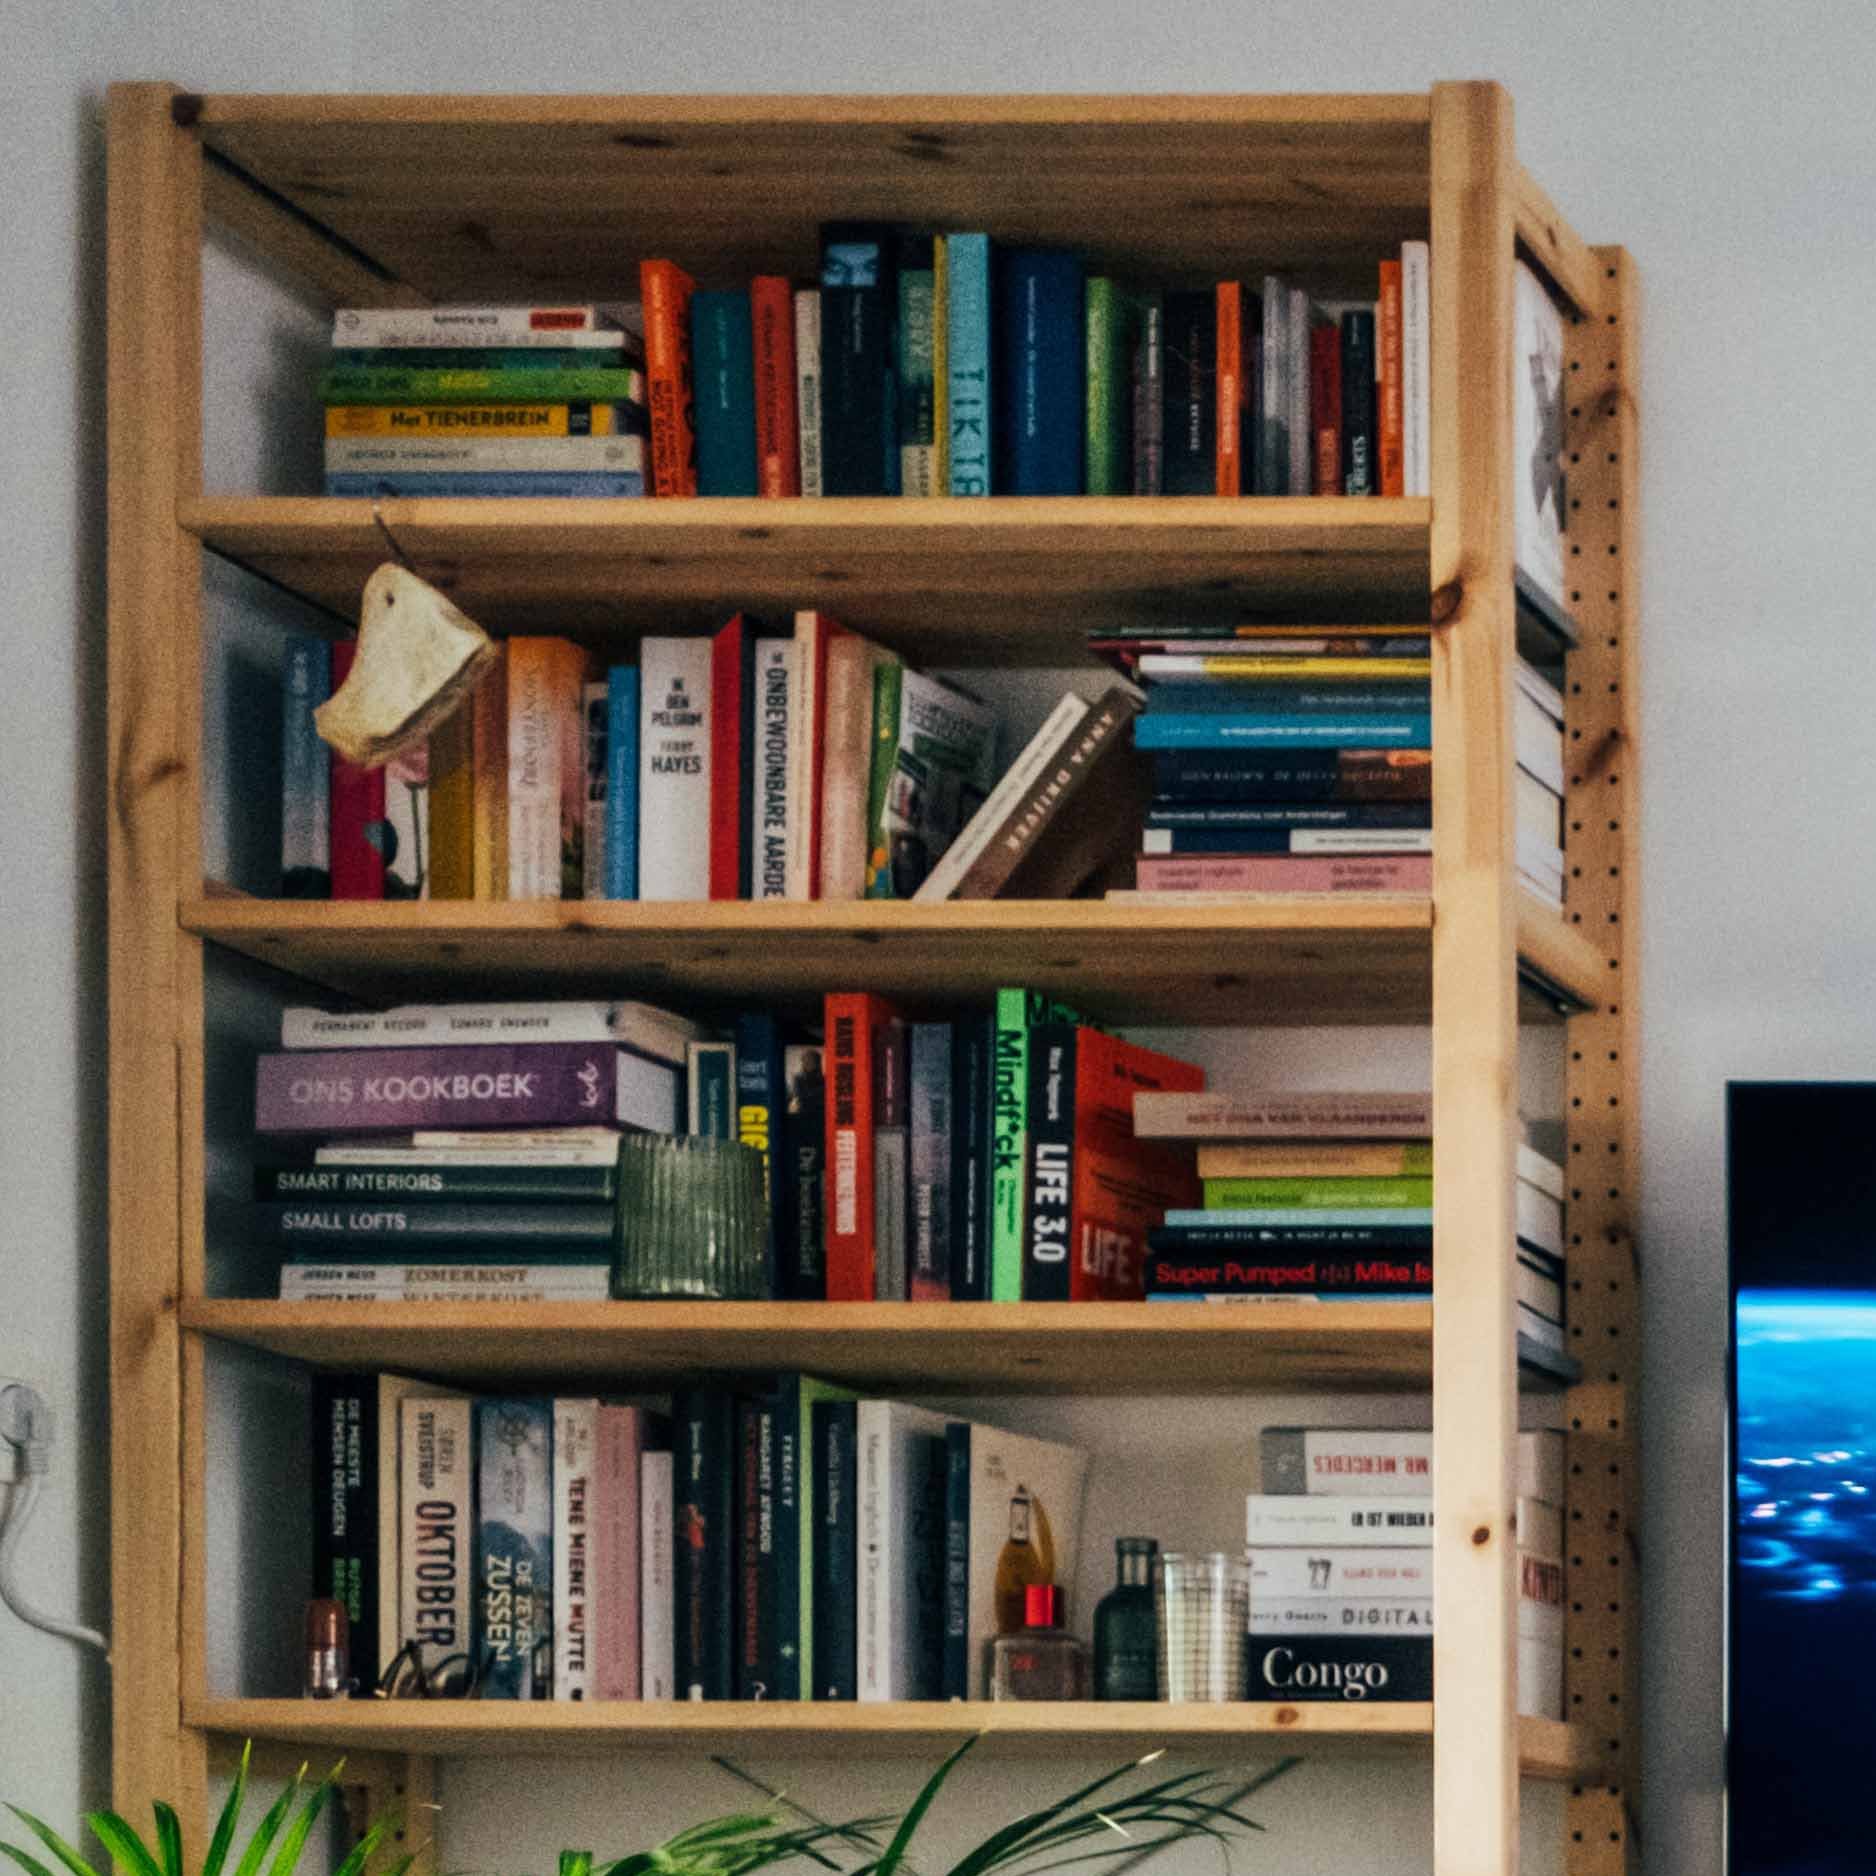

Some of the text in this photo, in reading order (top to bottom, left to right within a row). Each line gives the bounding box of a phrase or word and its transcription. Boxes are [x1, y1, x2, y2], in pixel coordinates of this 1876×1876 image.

[426, 410, 550, 427] TIENERBREIN
[651, 755, 702, 775] HAYES
[765, 667, 789, 828] ONBEWOONBARE
[1068, 711, 1118, 768] ANNA
[763, 834, 788, 898] AARDE
[288, 1072, 534, 1105] ONS KOOKBOEK
[276, 1172, 444, 1193] SMART INTERIORS
[1033, 1142, 1069, 1263] LIFE 3.0
[281, 1212, 407, 1231] SMALL LOFTS
[403, 1266, 529, 1284] ZOMERKOST
[1081, 1221, 1133, 1285] LIFE
[1156, 1263, 1219, 1284] Super
[1224, 1262, 1316, 1286] Pumped
[1354, 1263, 1411, 1283] Mike
[1313, 1455, 1430, 1476] MR MERCEDES
[415, 1500, 457, 1646] OKTOBER
[487, 1553, 511, 1662] ZUSSEN
[514, 1560, 533, 1656] DE ZEVEN
[567, 1603, 587, 1673] MUTTE
[1262, 1646, 1390, 1700] Congo
